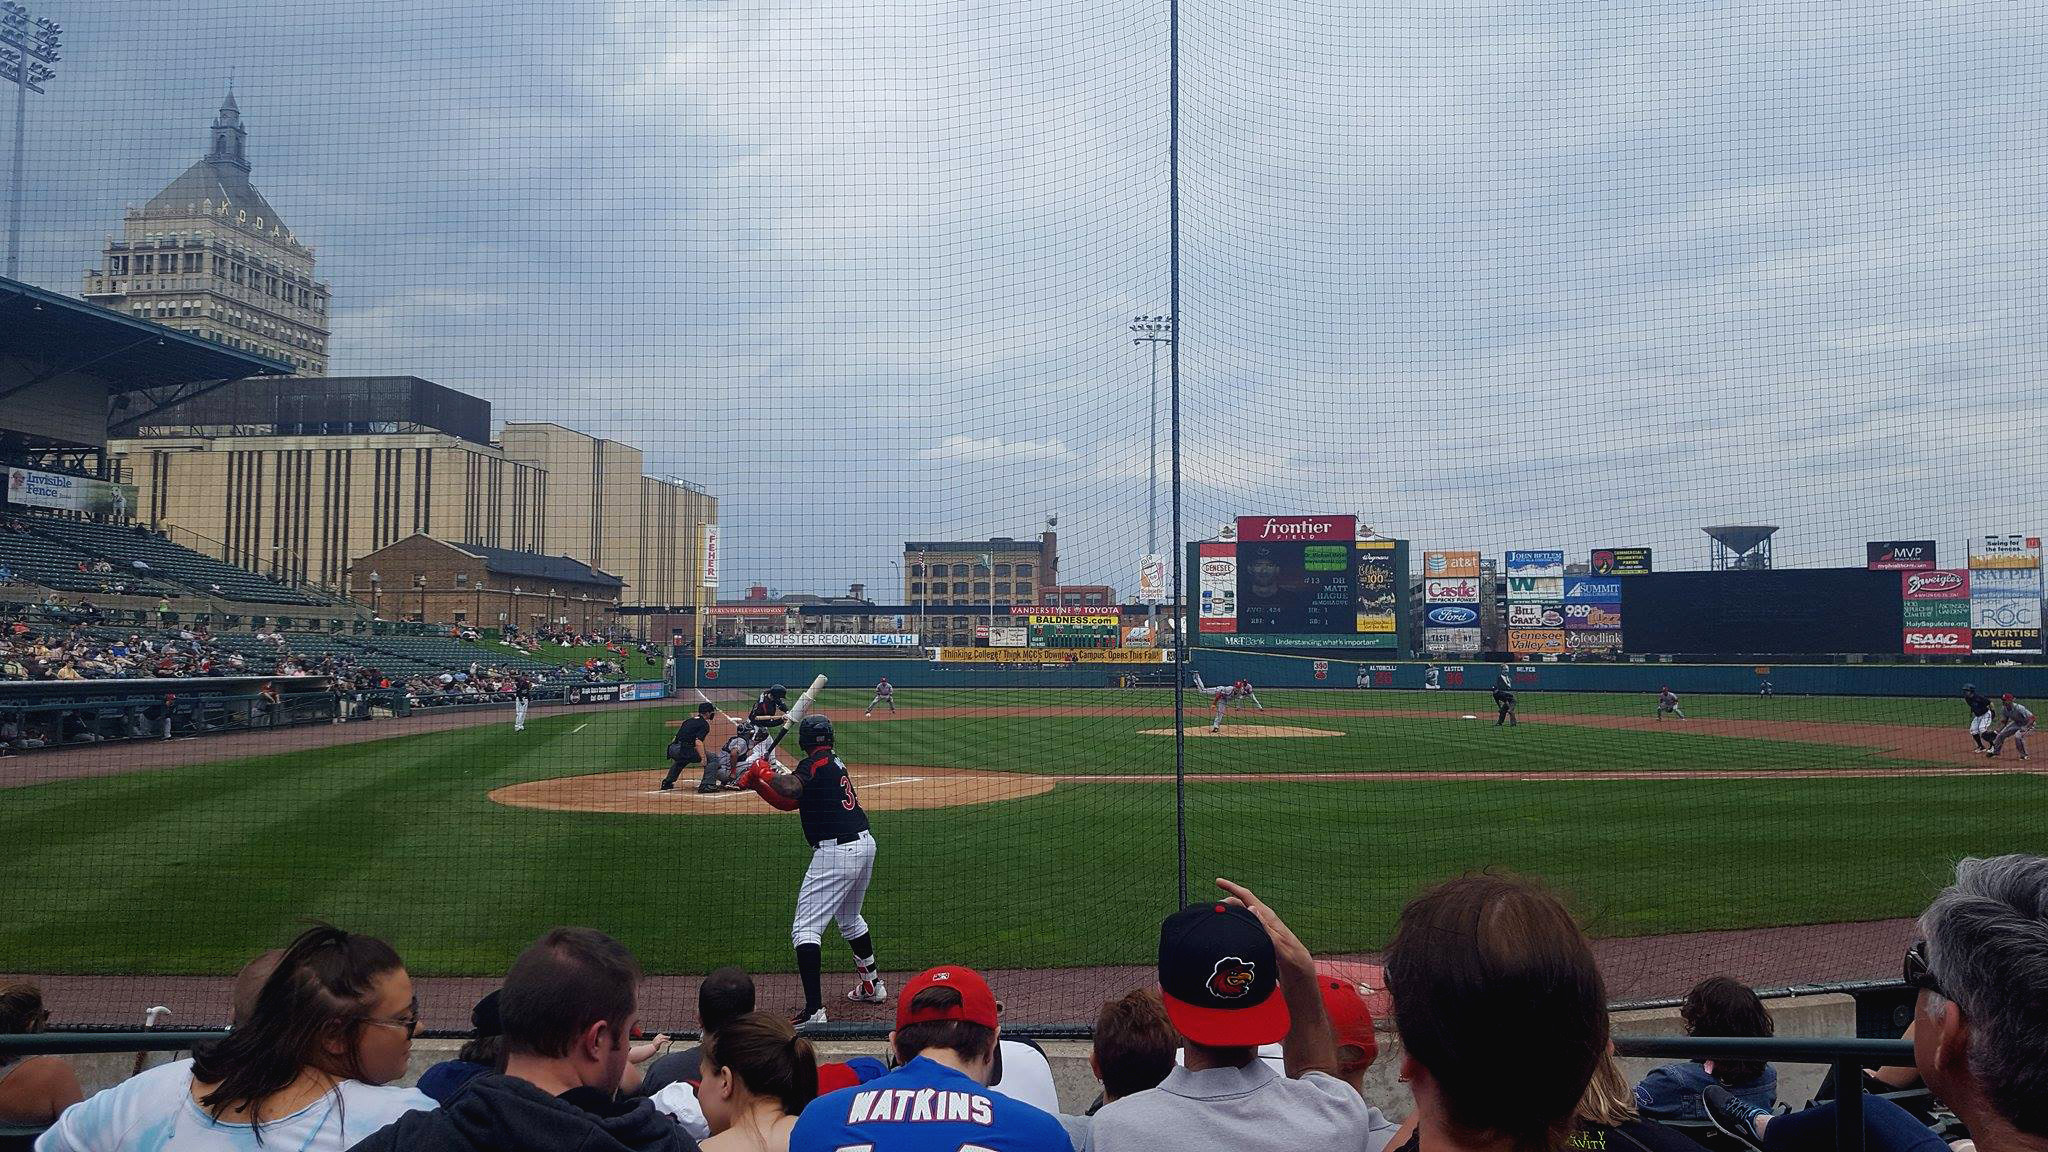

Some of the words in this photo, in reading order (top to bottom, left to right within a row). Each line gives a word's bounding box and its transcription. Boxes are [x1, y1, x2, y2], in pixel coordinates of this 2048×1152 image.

[221, 200, 296, 245] KODAK
[27, 472, 72, 488] Invisible
[26, 484, 58, 497] Fence
[1260, 518, 1332, 538] frontier
[707, 535, 716, 576] FEHER
[1894, 547, 1922, 558] MVP
[1205, 564, 1231, 572] GENESEE
[1451, 557, 1478, 568] at&t
[1580, 584, 1620, 593] SUMMIT
[1084, 606, 1120, 614] TOYOTA
[1438, 609, 1467, 621] Ford
[1515, 606, 1535, 615] BILL
[1036, 616, 1112, 625] BALDNESS.com
[1511, 615, 1541, 625] GRAY'S
[1981, 608, 2031, 628] ROC
[1511, 630, 1562, 640] Genesee
[1580, 632, 1622, 643] foodlink
[1906, 633, 1959, 645] ISAAC
[1974, 629, 2039, 638] ADVERTISE
[752, 634, 815, 645] ROCHESTER
[818, 634, 870, 645] REGIONAL
[872, 635, 913, 644] HEALTH
[1224, 636, 1246, 645] M&T
[1275, 638, 1322, 647] Understanding
[1991, 639, 2022, 648] HERE
[1511, 640, 1544, 651] Valley
[944, 649, 972, 660] Thinking
[1003, 649, 1021, 659] Think
[1108, 650, 1128, 660] Opens
[1129, 650, 1143, 659] This
[705, 660, 719, 668] 335
[1314, 662, 1328, 671] 390
[848, 1088, 993, 1126] WATKINS
